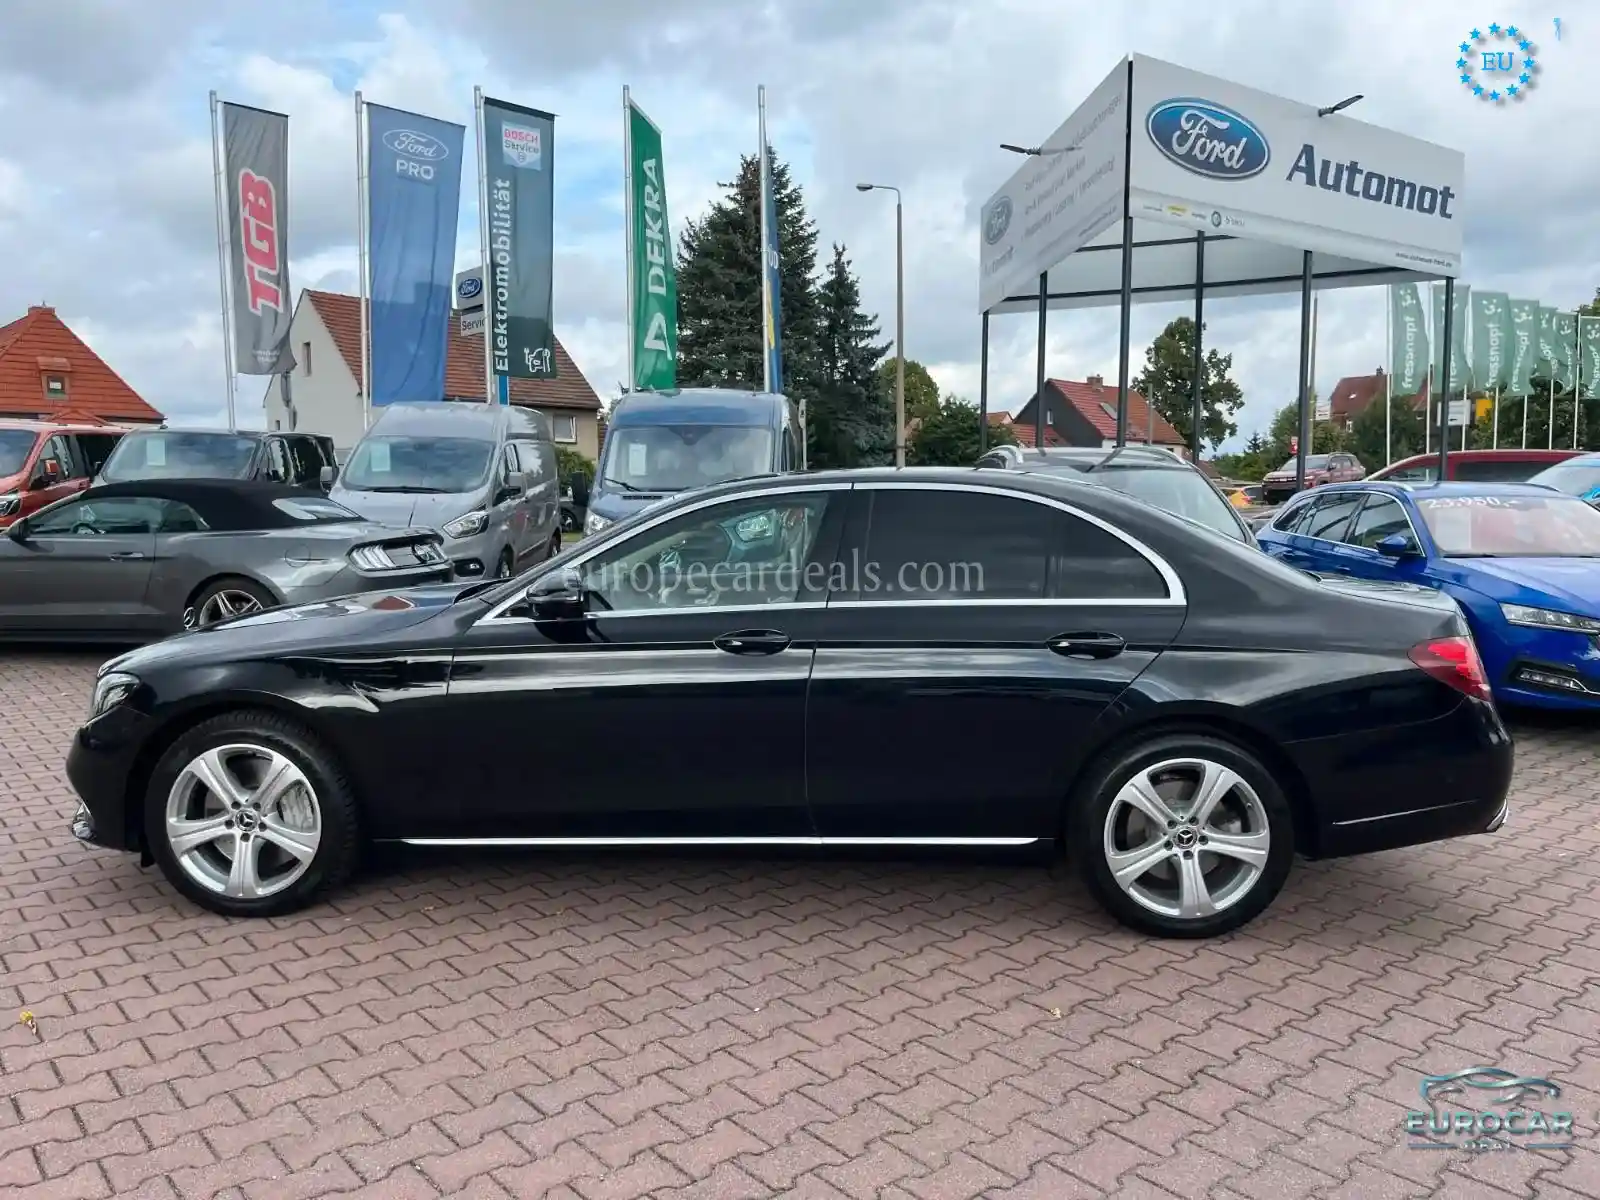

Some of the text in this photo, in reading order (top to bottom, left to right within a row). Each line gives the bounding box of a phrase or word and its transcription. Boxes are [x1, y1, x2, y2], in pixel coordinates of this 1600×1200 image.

[393, 131, 439, 158] Ford
[396, 159, 435, 180] PRO
[504, 128, 538, 144] BOSCH
[1171, 109, 1249, 170] Ford
[1286, 143, 1456, 220] Automot
[238, 167, 284, 317] TGB
[643, 157, 667, 297] DEKRA
[492, 178, 511, 372] Elektromobilität
[1401, 316, 1418, 389] fressnapf
[1485, 322, 1504, 389] fressnapf
